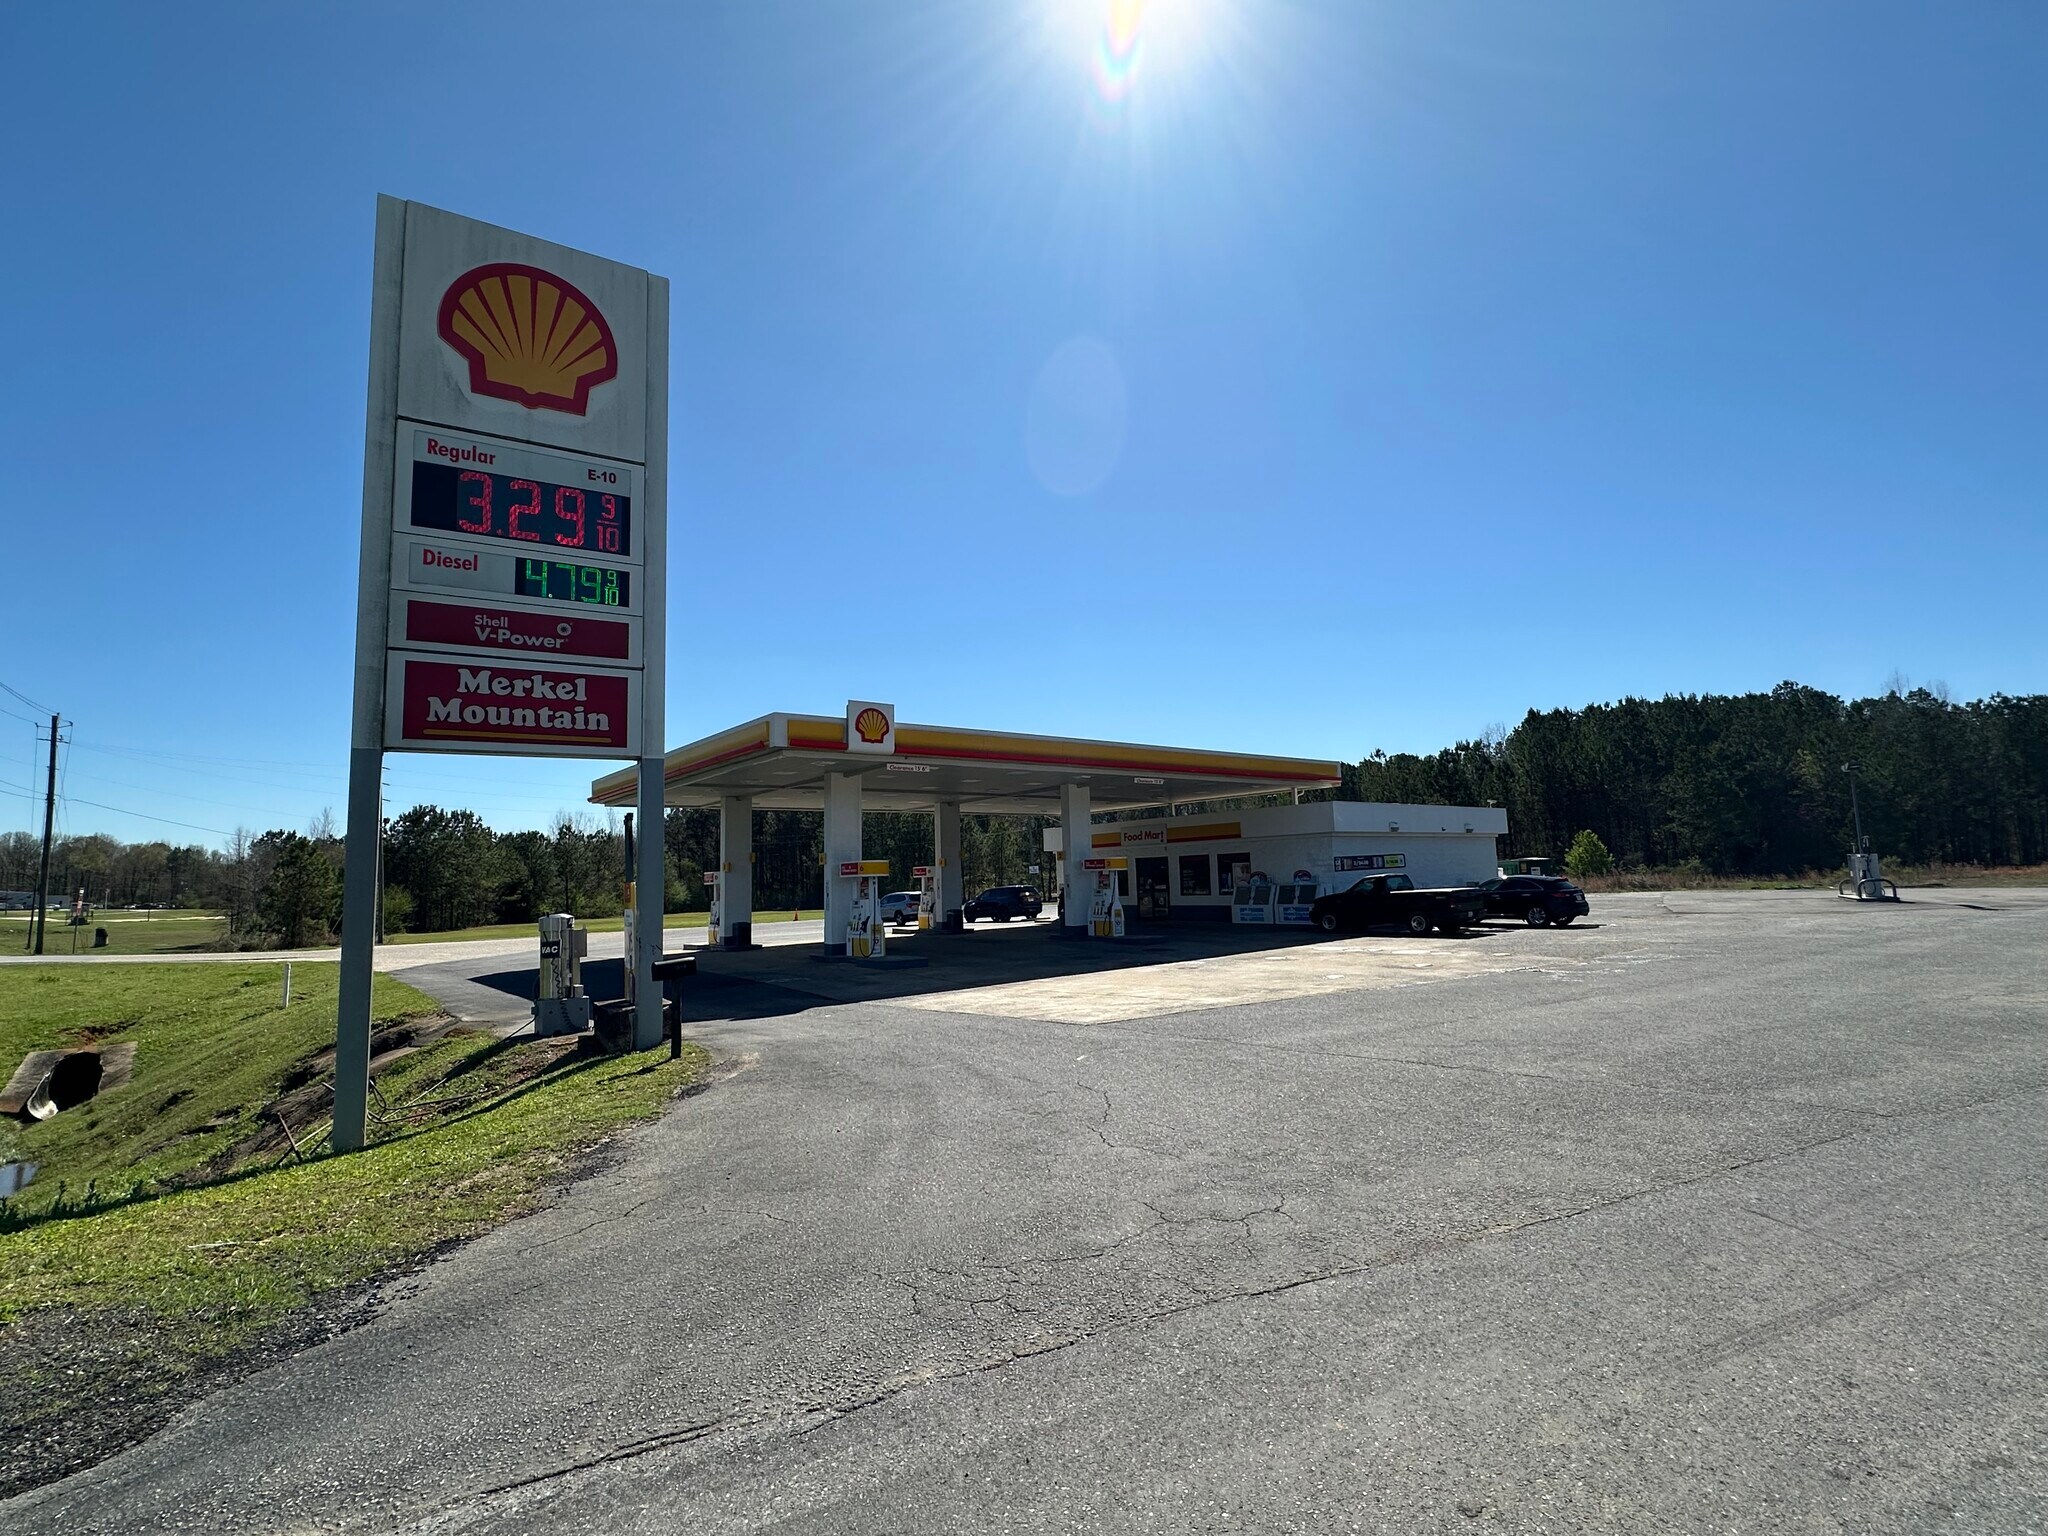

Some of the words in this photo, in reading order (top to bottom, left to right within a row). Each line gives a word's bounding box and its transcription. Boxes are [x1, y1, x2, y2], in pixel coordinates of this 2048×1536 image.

[427, 438, 496, 465] Regular
[588, 468, 617, 485] E-10
[458, 470, 586, 547] 3.29
[422, 548, 479, 572] Diesel
[525, 559, 601, 604] 4.79
[474, 614, 509, 629] Shell
[475, 627, 565, 649] V-Power
[456, 668, 587, 701] Merkel
[426, 696, 611, 731] Mountain
[1124, 830, 1143, 842] Food
[1144, 830, 1164, 841] Mart
[541, 945, 559, 954] VAC
